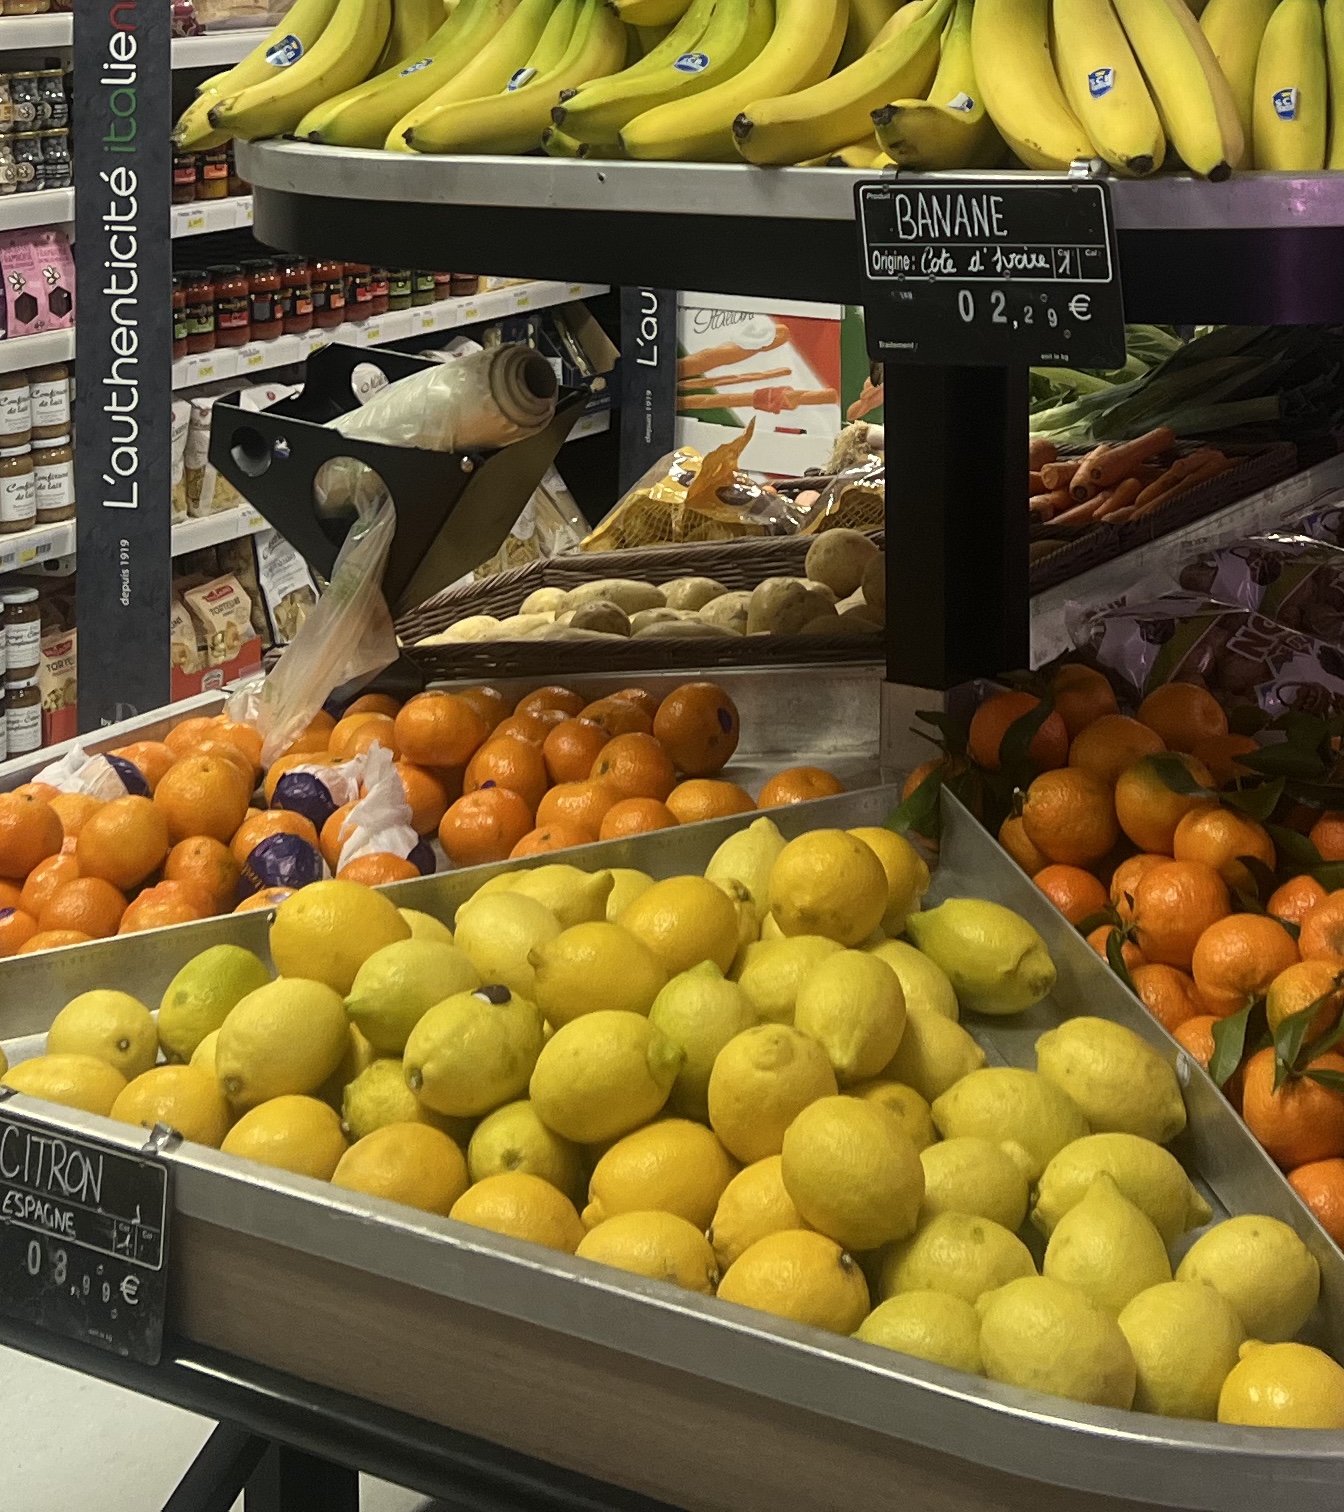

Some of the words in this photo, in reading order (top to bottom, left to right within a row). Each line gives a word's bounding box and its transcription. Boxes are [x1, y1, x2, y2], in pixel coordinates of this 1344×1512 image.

[895, 192, 1008, 241] BANANE
[1068, 293, 1092, 321] €
[101, 164, 139, 509] L'authenticité
[119, 538, 130, 566] 1919
[119, 568, 132, 606] depuis
[0, 1125, 103, 1204] CITRON
[2, 1190, 77, 1240] ESPAGNE
